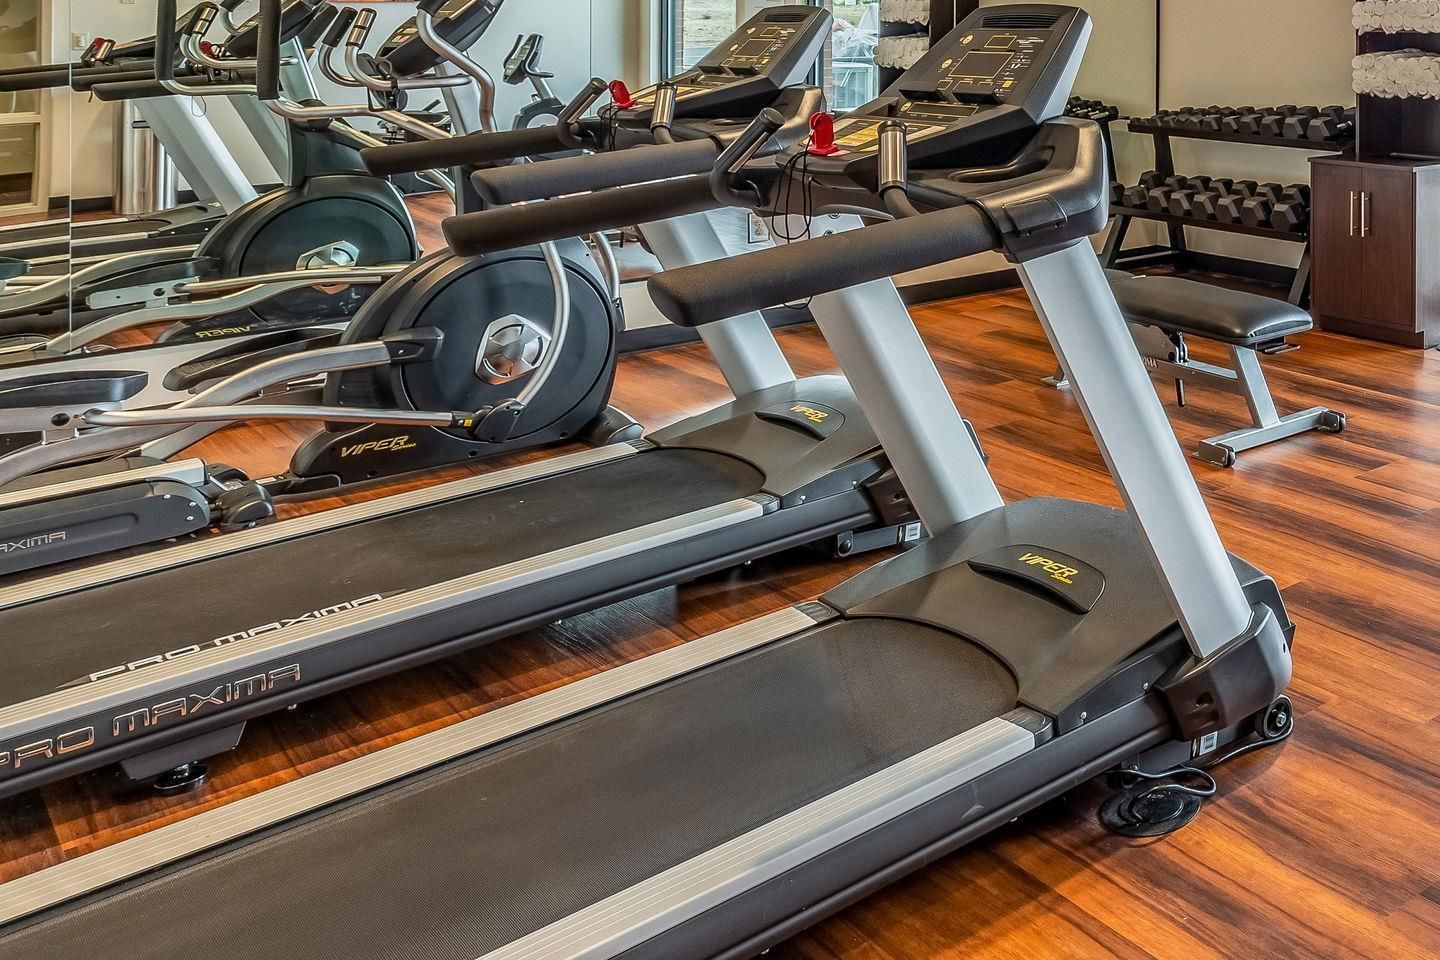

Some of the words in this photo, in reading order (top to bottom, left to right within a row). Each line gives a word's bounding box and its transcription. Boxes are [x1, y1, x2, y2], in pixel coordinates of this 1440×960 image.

[341, 435, 410, 458] VIPER
[1017, 552, 1080, 578] VIPER
[89, 644, 201, 682] PRO
[214, 594, 383, 646] MAXIMA
[0, 726, 95, 768] RO
[113, 663, 301, 737] MAXIMA
